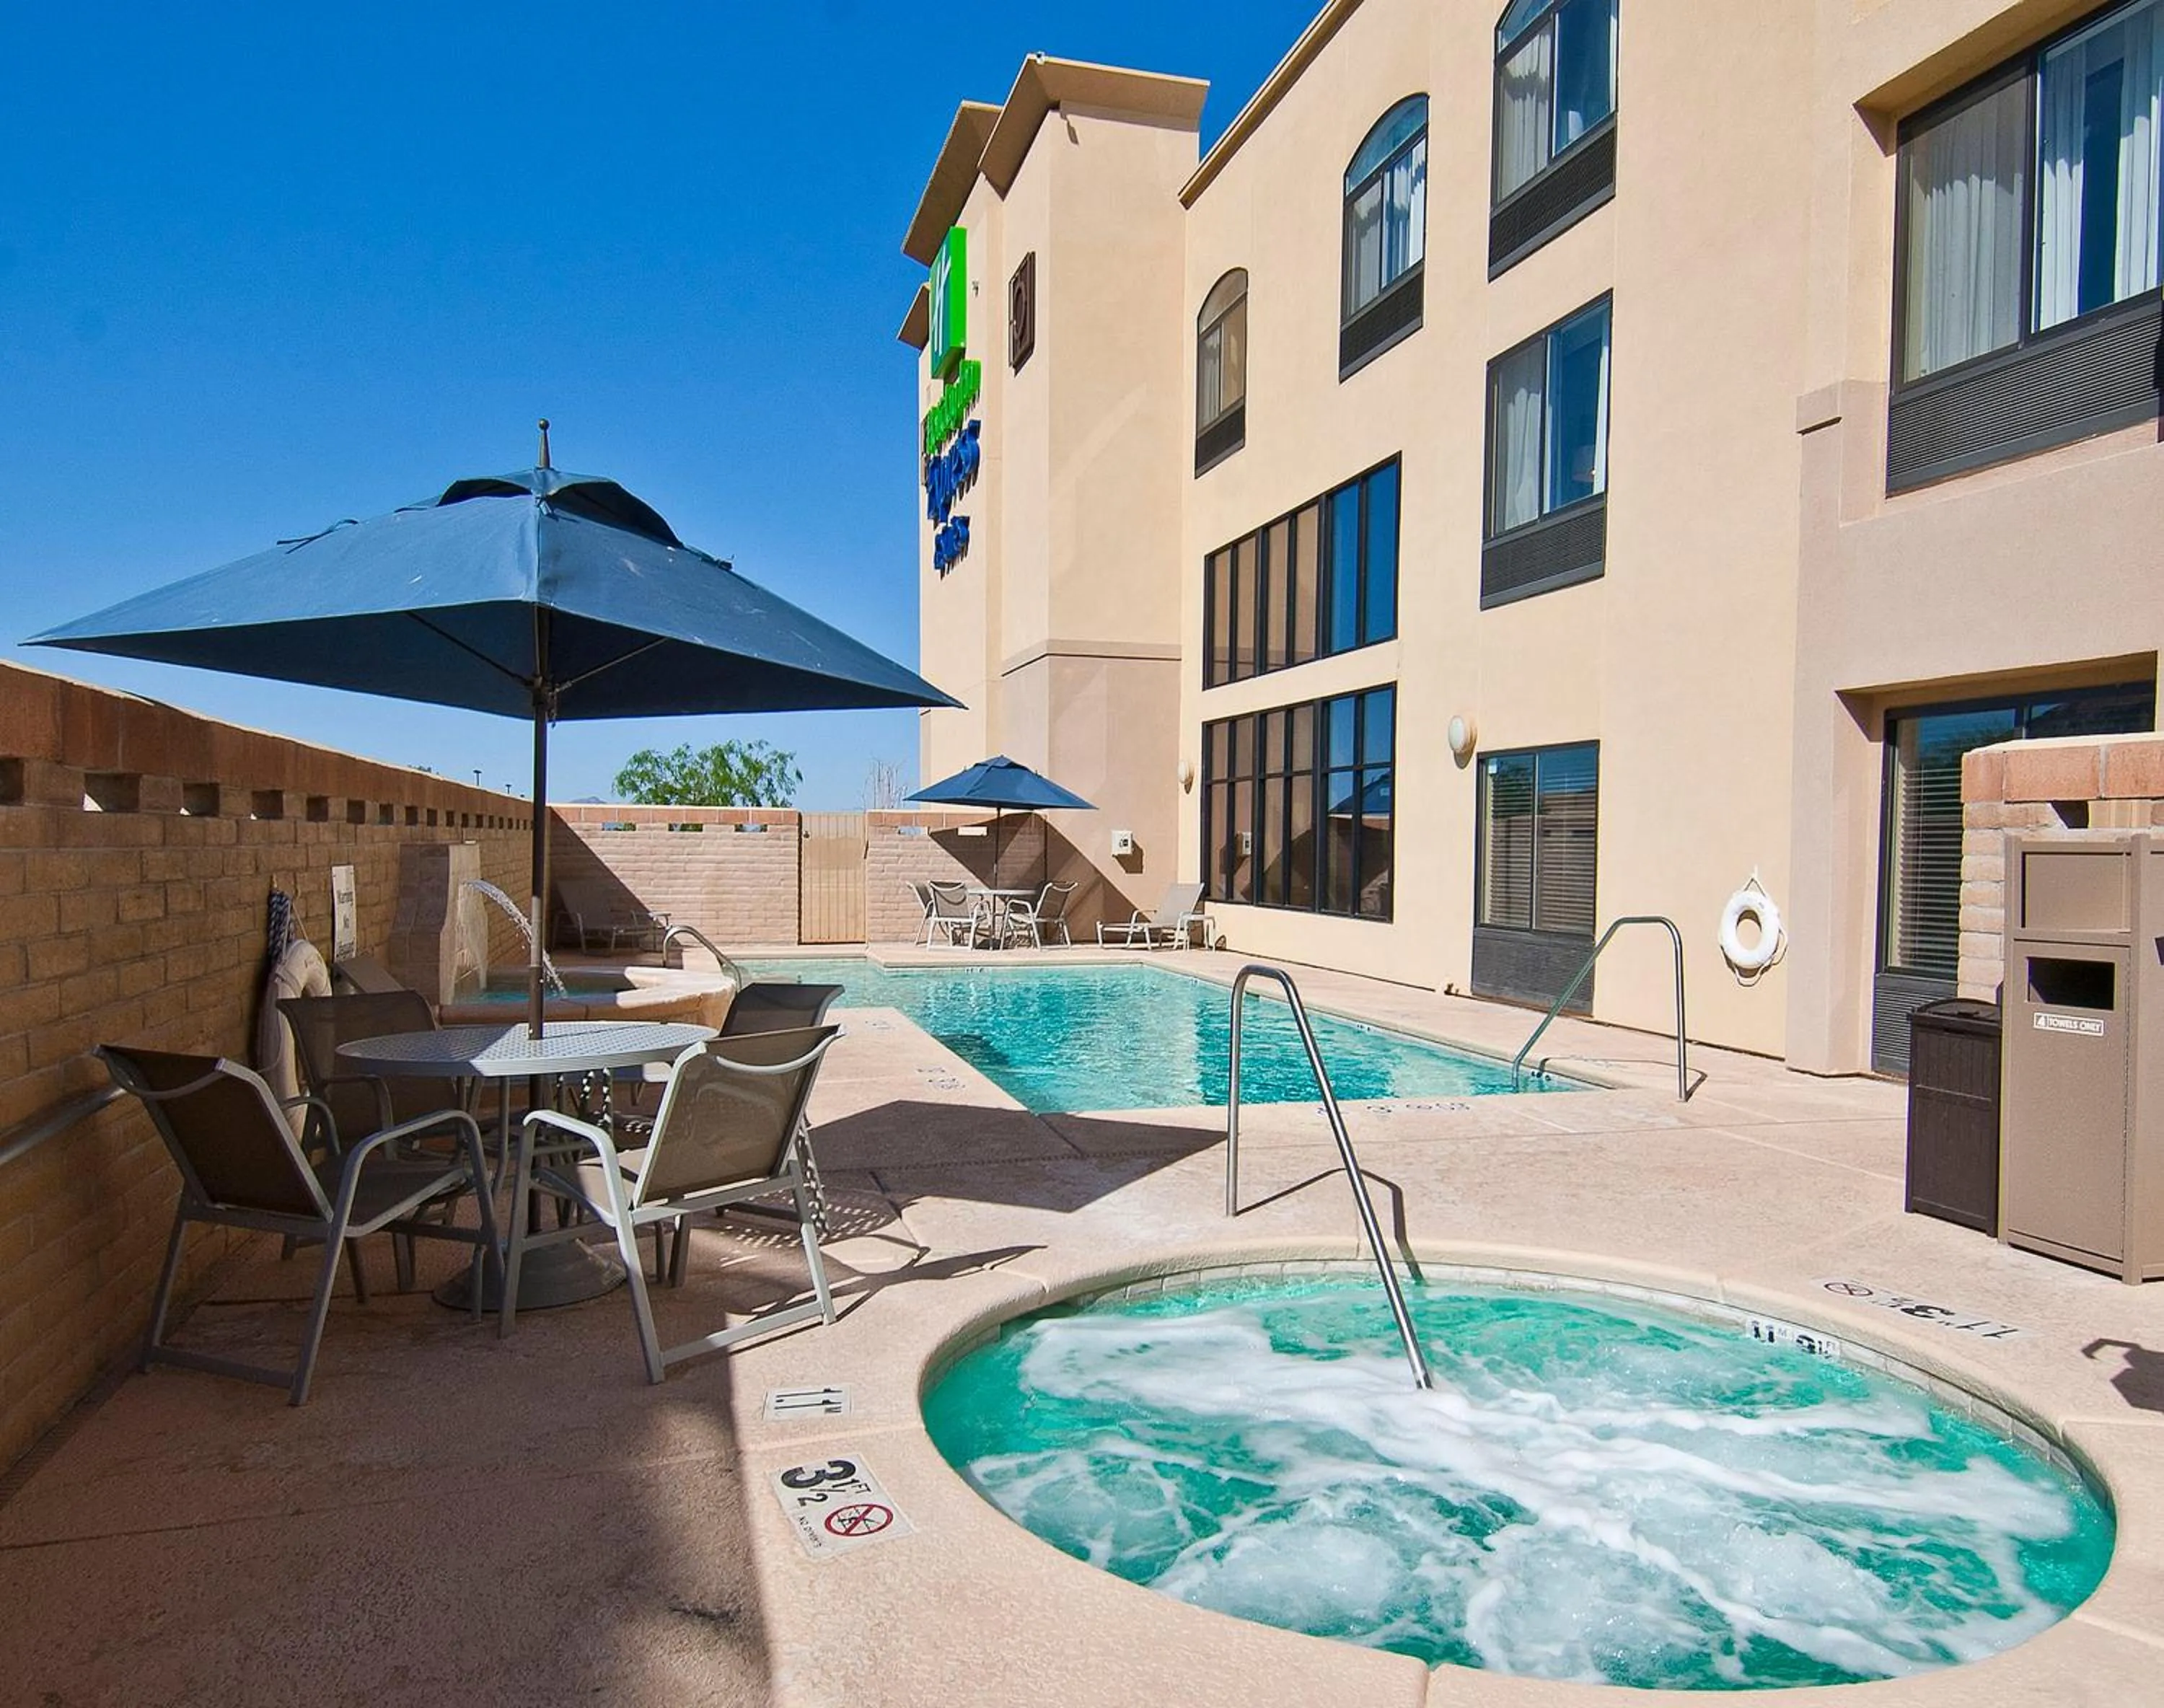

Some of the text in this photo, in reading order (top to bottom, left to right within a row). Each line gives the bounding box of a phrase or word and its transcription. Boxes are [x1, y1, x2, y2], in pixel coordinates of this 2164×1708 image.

[2049, 1018, 2101, 1032] TOWELS ONLY
[851, 1483, 871, 1493] FT
